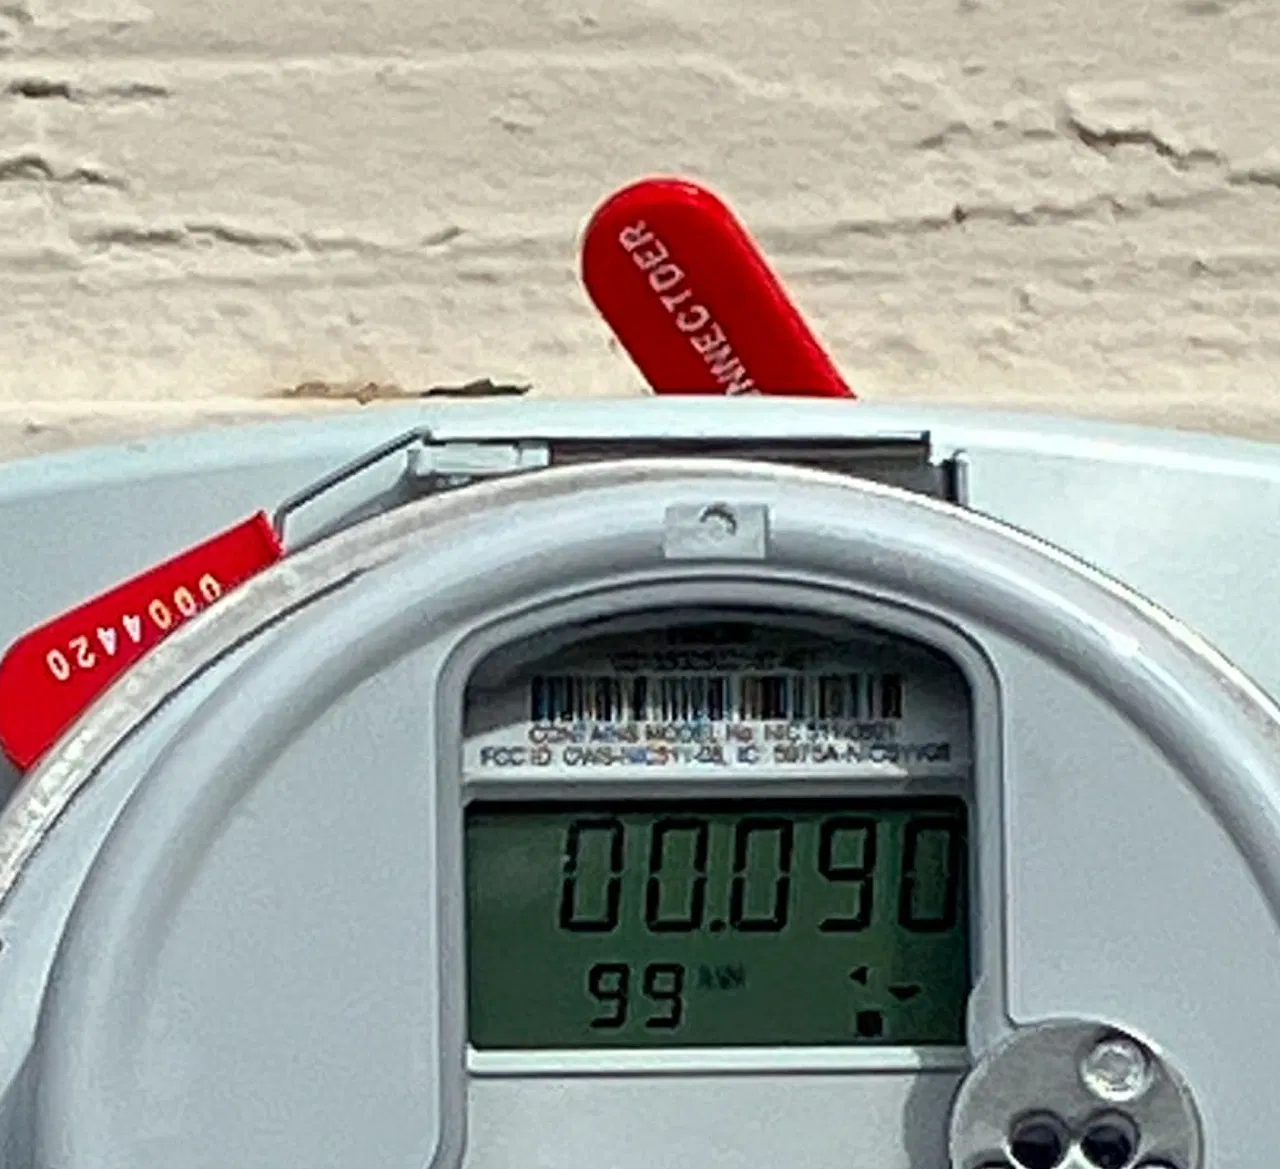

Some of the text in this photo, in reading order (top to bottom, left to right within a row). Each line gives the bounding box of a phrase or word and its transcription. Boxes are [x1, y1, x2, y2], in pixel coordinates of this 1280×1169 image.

[619, 219, 762, 395] NNECTDER
[45, 573, 221, 681] 0004420
[480, 746, 527, 767] FCC
[560, 816, 963, 932] 00.090
[588, 962, 685, 1029] 99
